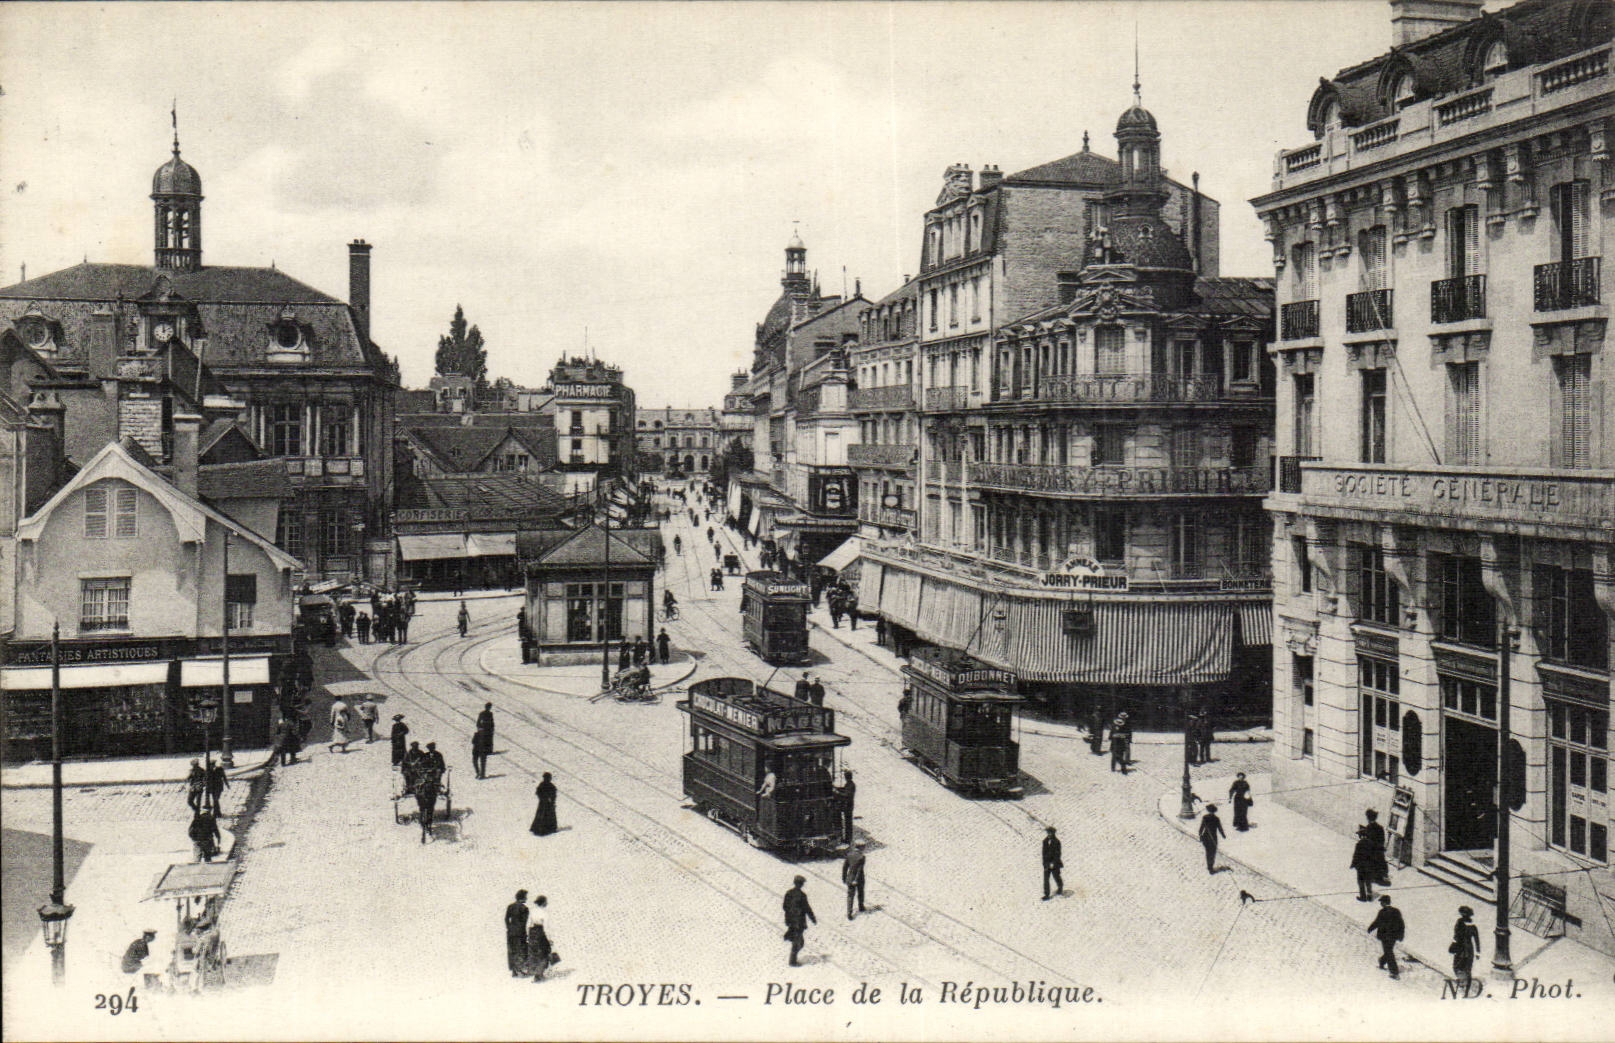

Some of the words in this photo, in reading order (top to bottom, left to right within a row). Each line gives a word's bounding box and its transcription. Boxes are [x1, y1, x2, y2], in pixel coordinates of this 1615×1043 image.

[555, 384, 612, 398] PHARMACIE
[1334, 474, 1411, 497] SOCIÉTÉ
[1433, 476, 1560, 508] GÉNÉRALE
[399, 509, 461, 521] CONFISERIE
[1065, 558, 1100, 574] ANNEXE
[1041, 573, 1127, 589] JORRY-PRIEUR
[767, 585, 808, 595] SUNLIGHT
[18, 650, 82, 664] FANTASIES
[87, 646, 158, 660] ARTISTIQUES
[958, 669, 1017, 684] DUBONNET
[767, 710, 830, 734] MAGGI
